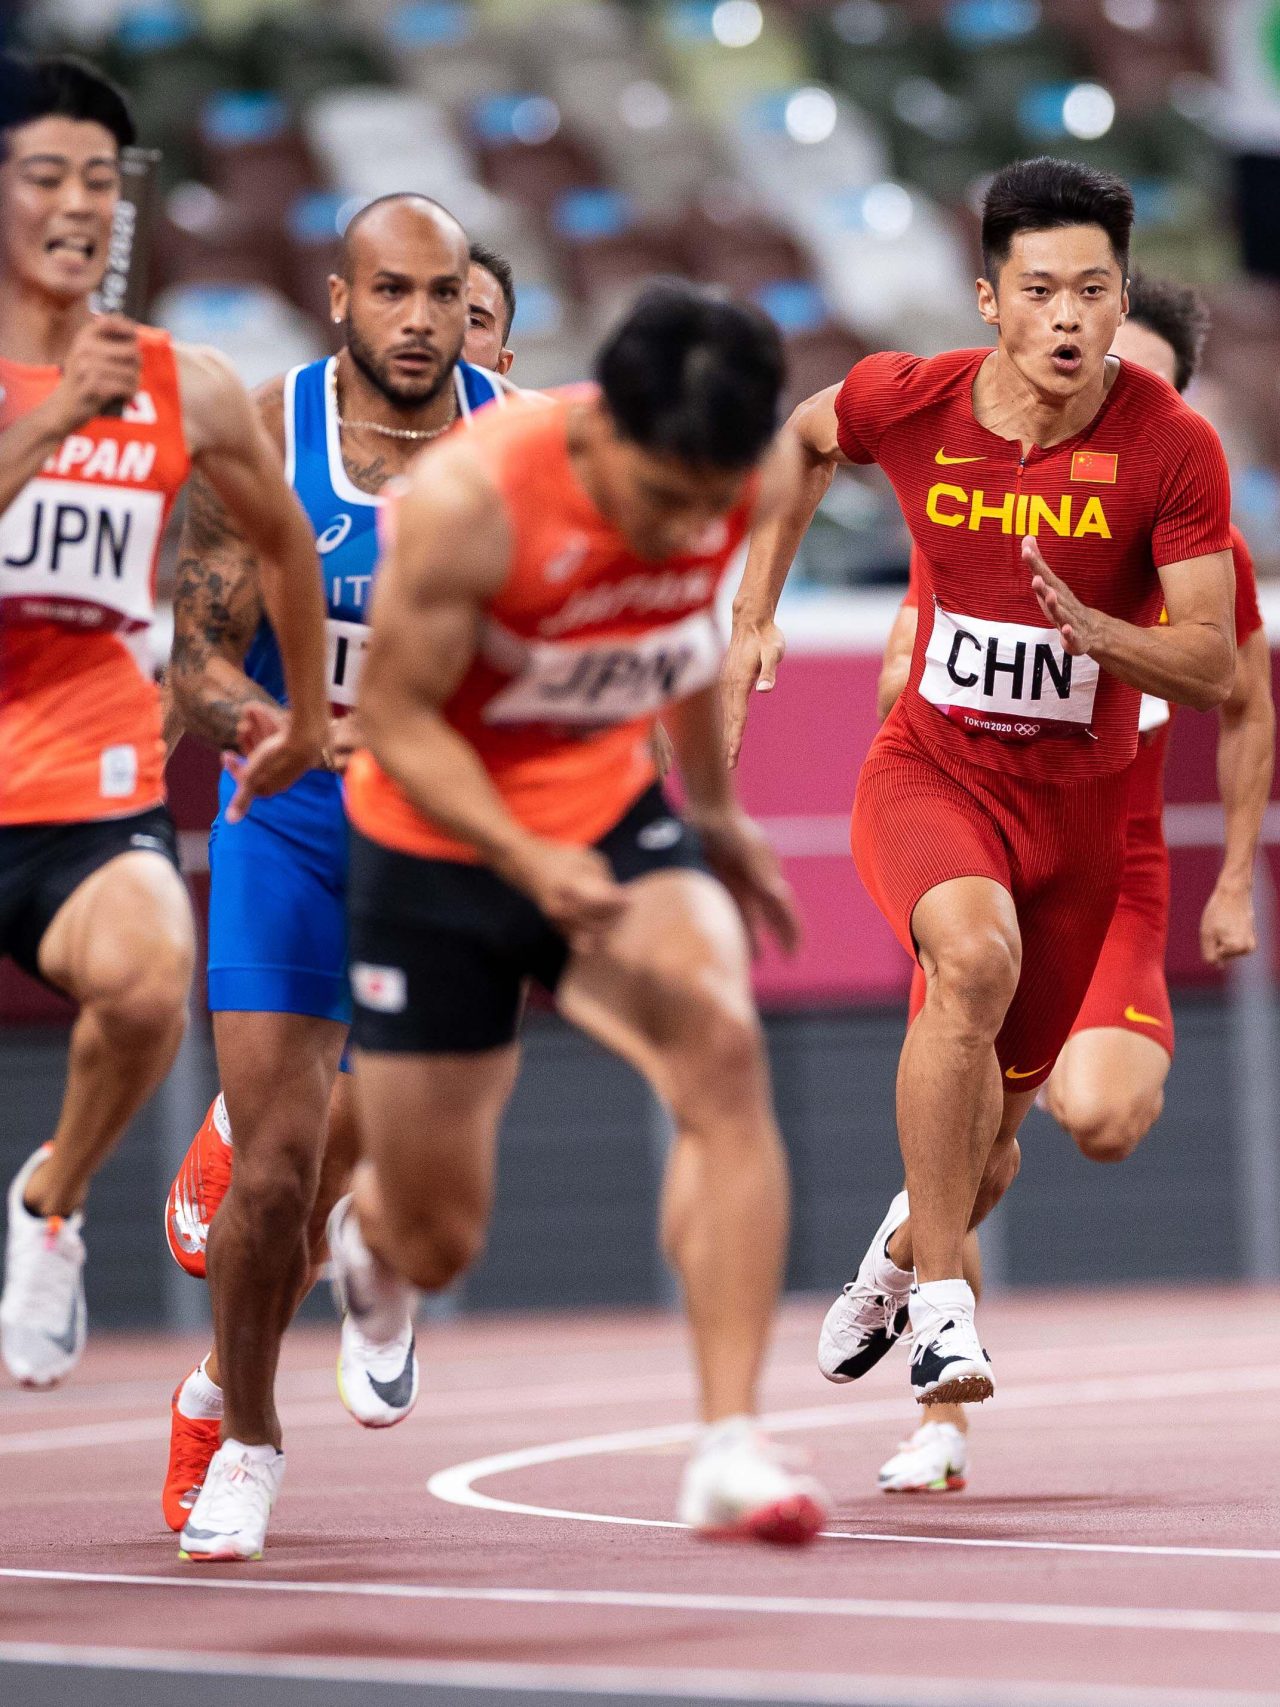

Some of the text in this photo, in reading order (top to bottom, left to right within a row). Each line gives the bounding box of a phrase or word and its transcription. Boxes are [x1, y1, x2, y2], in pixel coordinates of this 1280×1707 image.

[43, 434, 157, 482] PAN
[925, 482, 1112, 539] CHINA
[3, 500, 131, 579] JPN
[537, 644, 693, 702] JPN
[946, 629, 1073, 701] CHN
[963, 715, 1012, 733] TOKYO 2020
